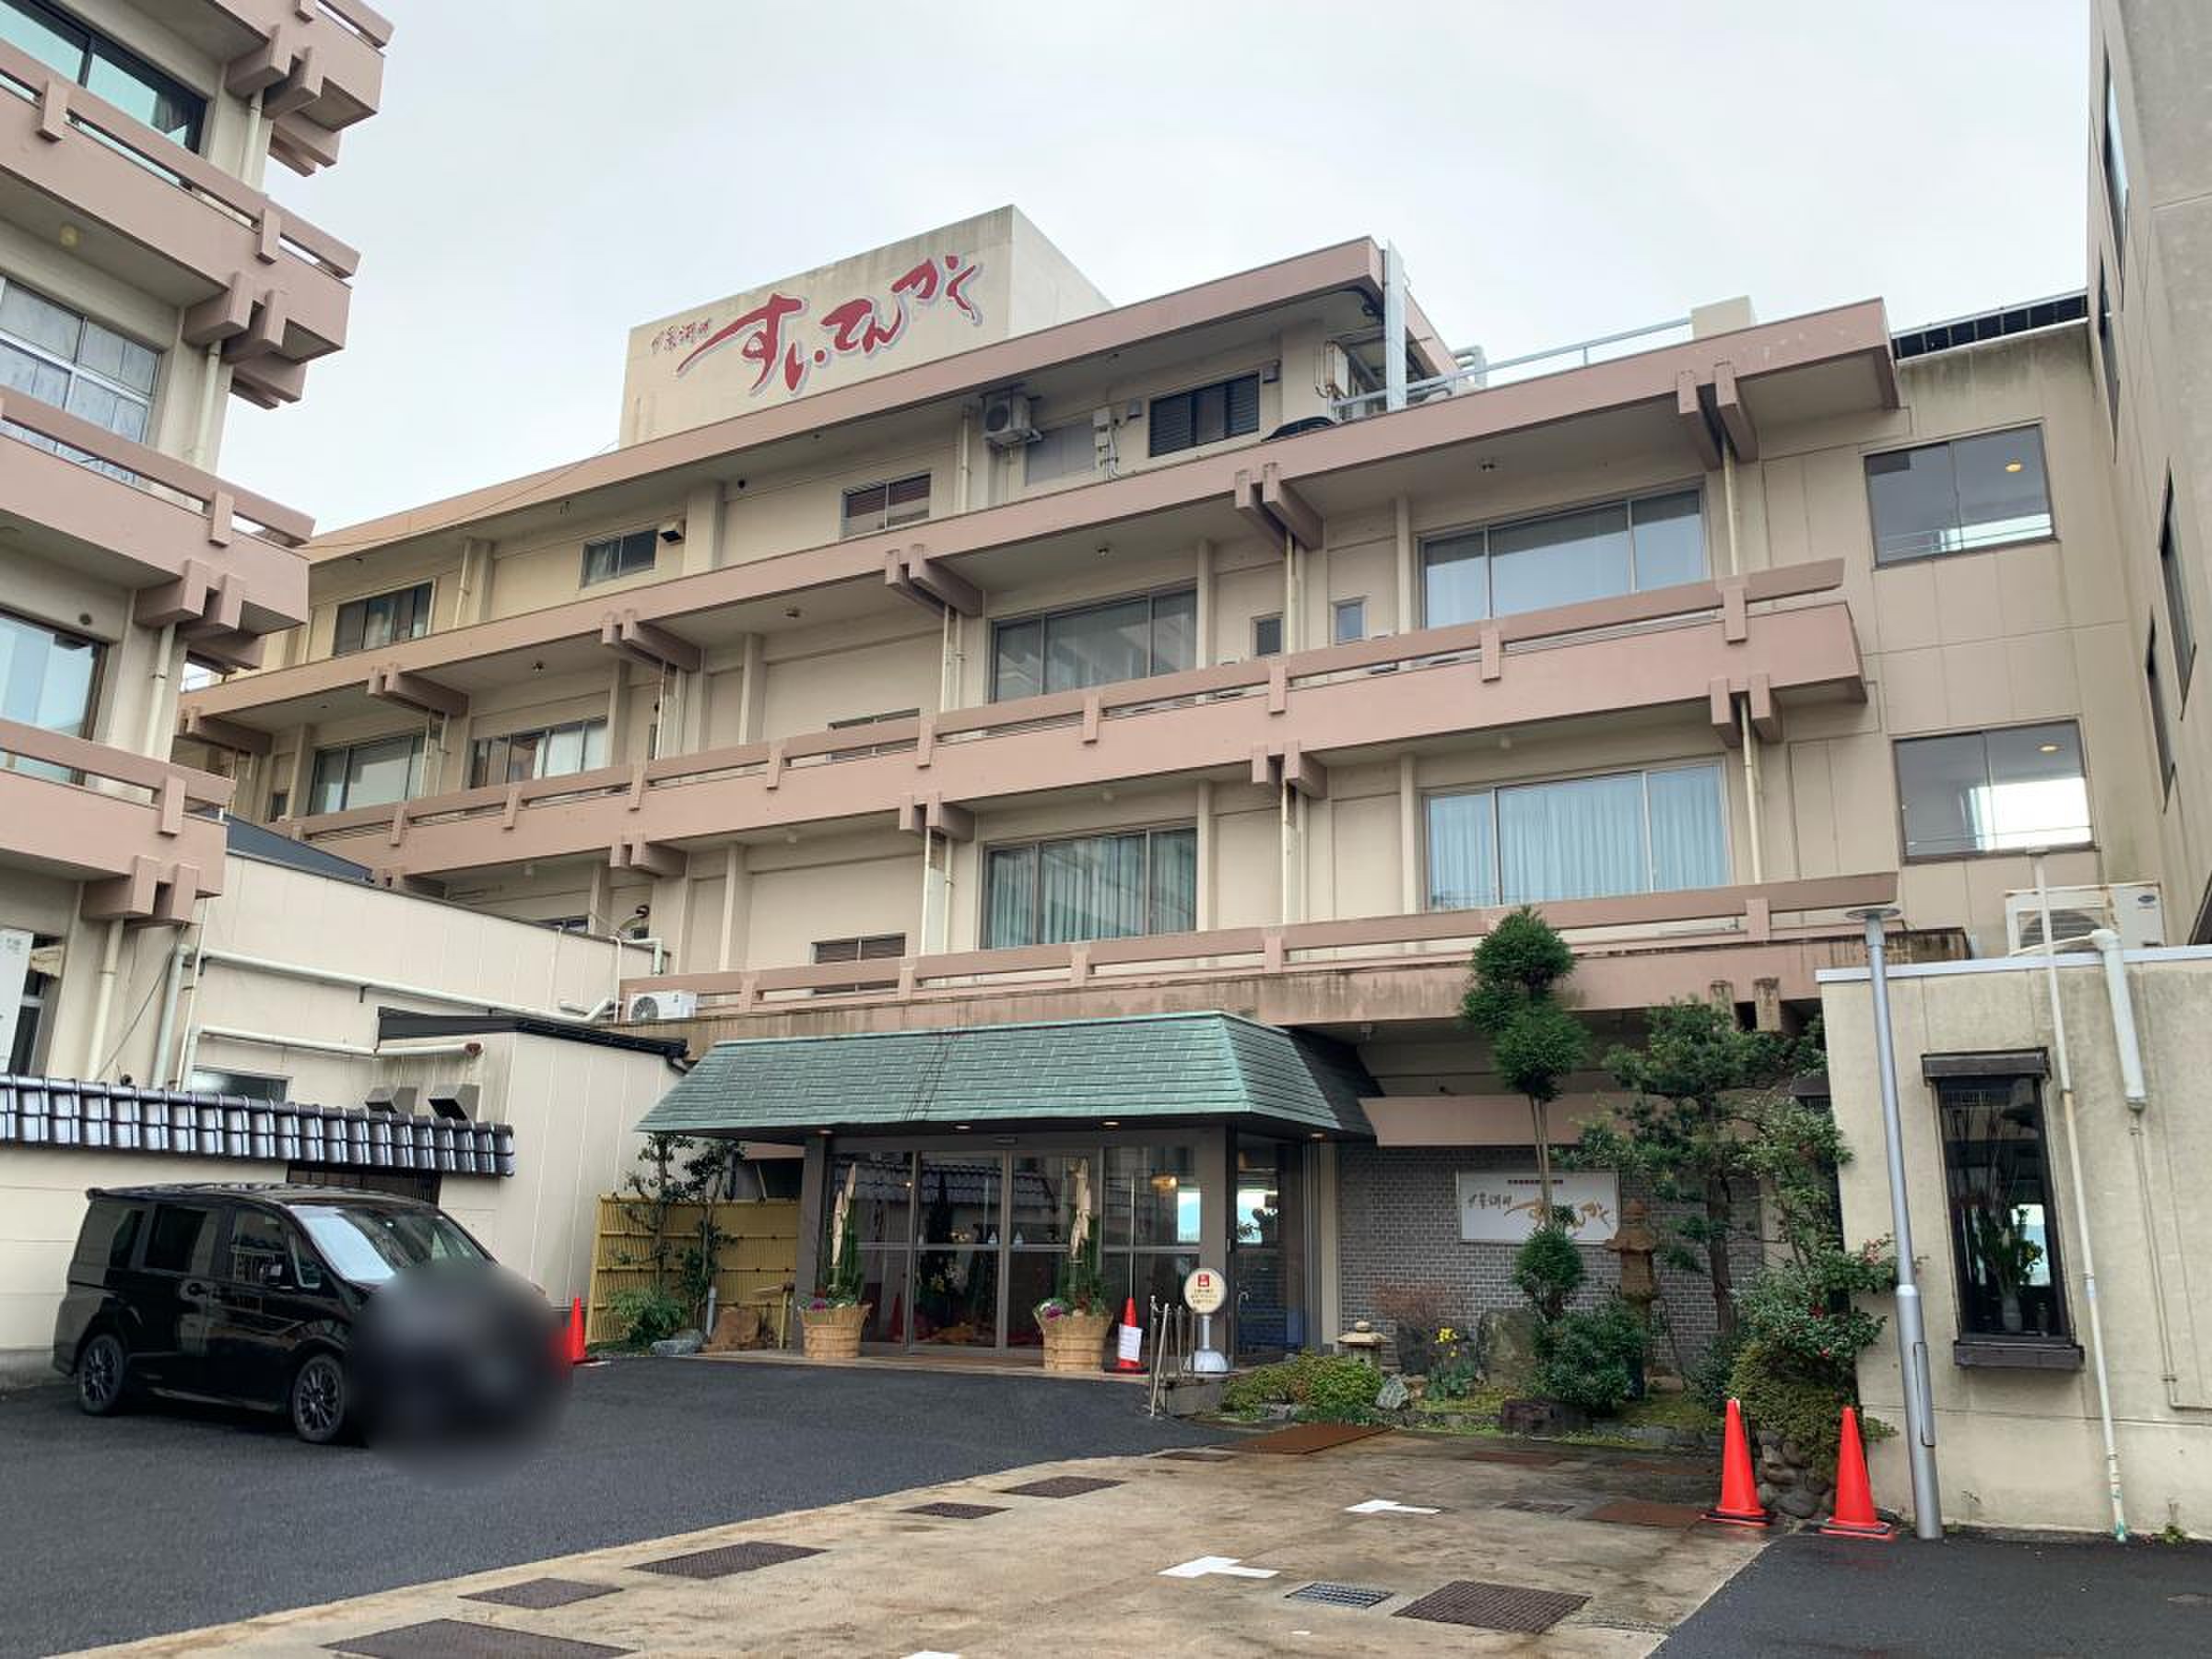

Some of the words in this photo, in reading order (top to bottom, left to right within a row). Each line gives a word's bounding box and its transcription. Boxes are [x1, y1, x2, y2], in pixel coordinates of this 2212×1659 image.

[677, 254, 979, 394] すいてんかく
